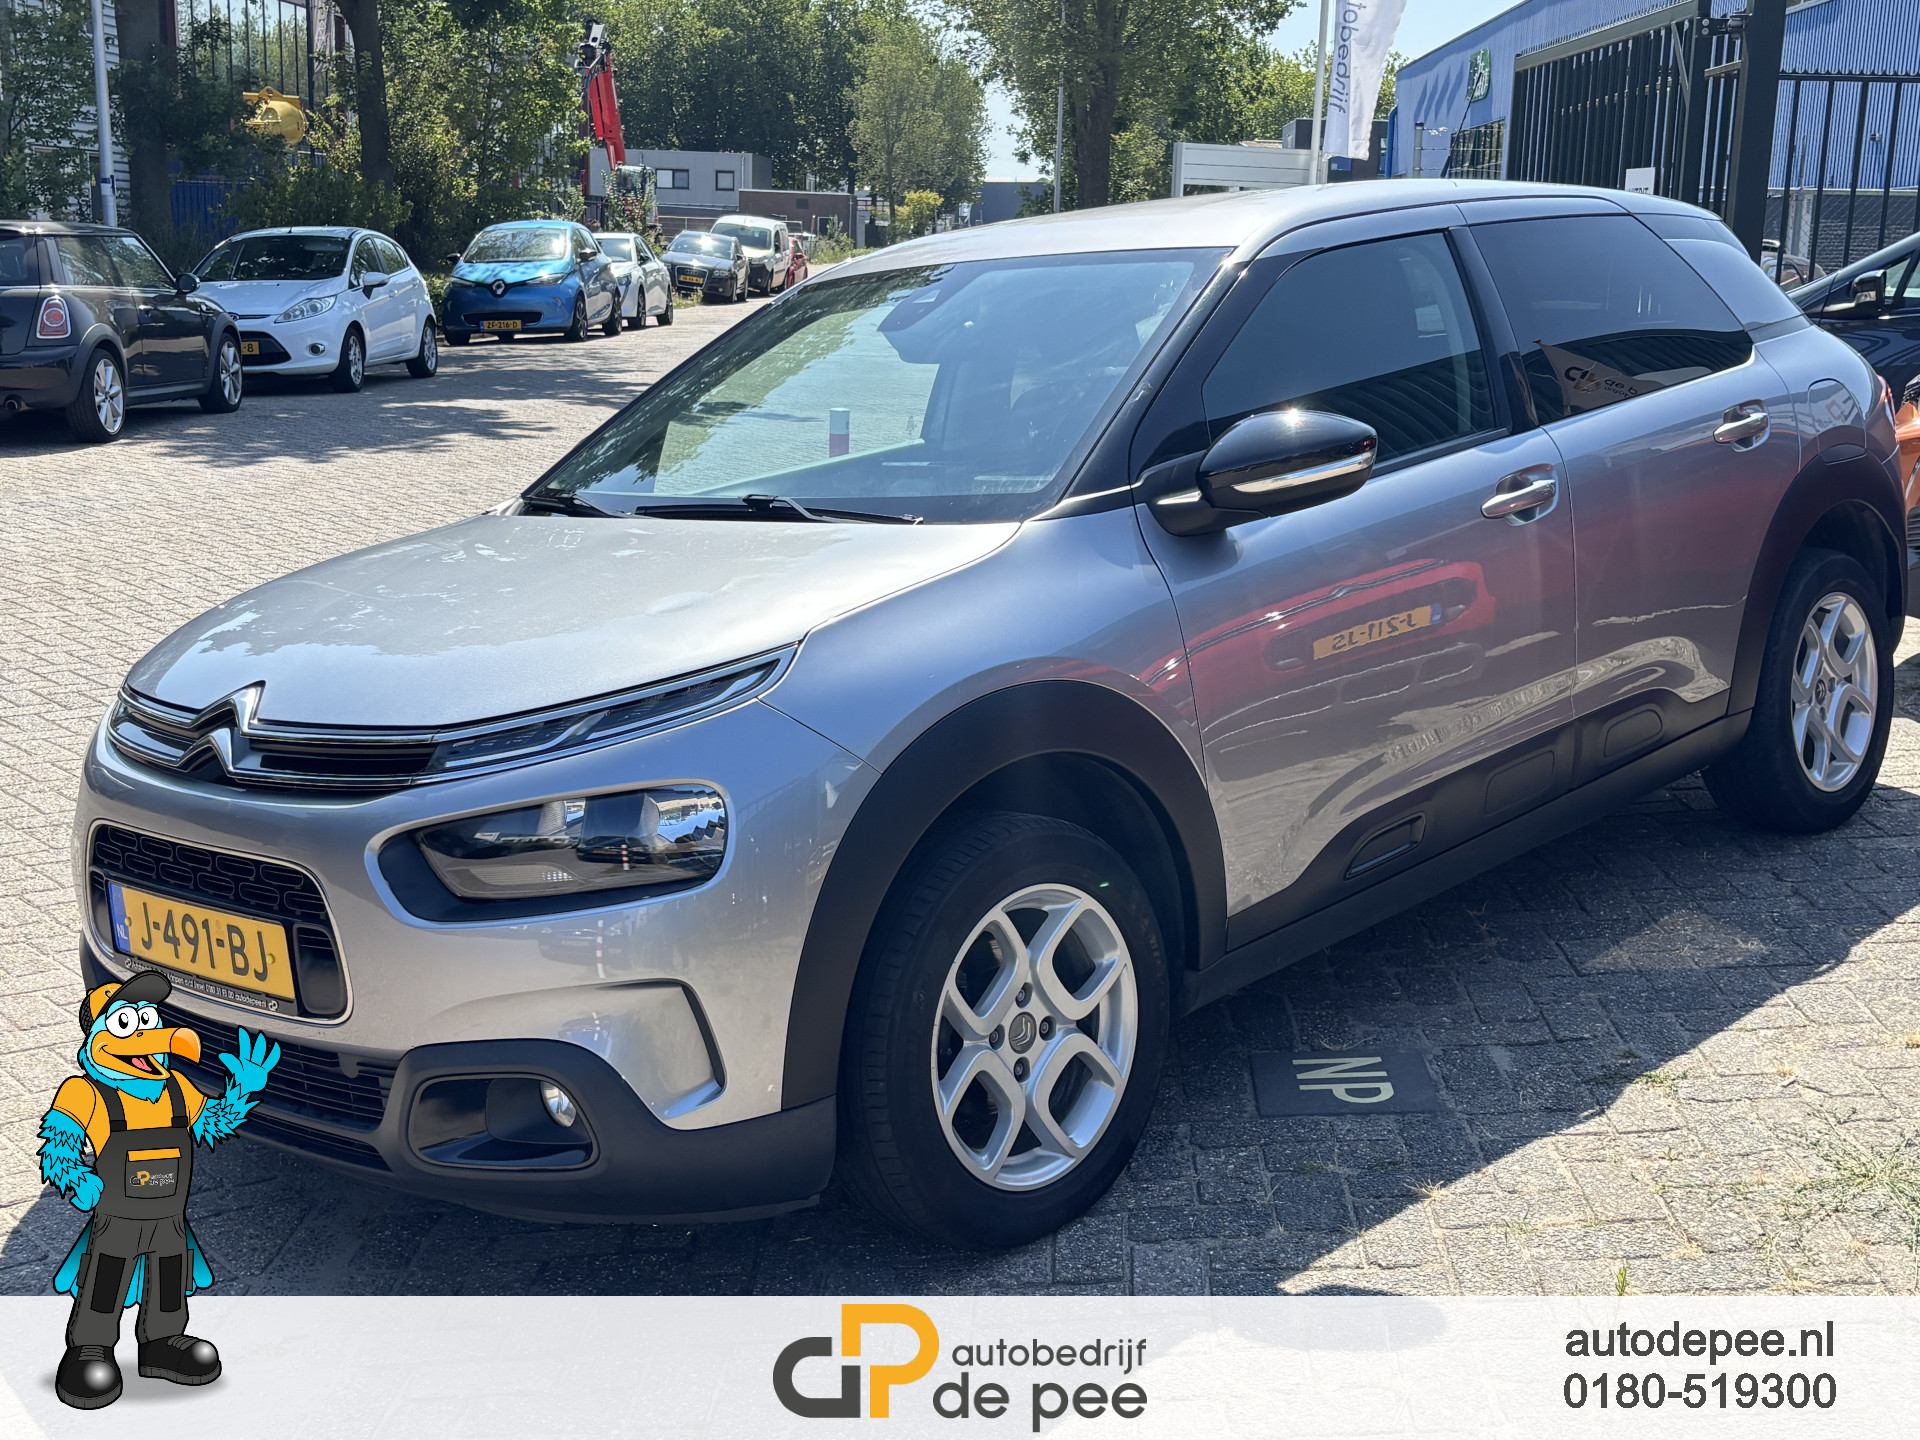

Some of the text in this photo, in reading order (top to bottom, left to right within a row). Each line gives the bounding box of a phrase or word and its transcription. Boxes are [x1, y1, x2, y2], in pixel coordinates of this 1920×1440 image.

[116, 923, 129, 940] NL
[141, 902, 269, 982] J-491-BJ
[1292, 1056, 1395, 1104] NP
